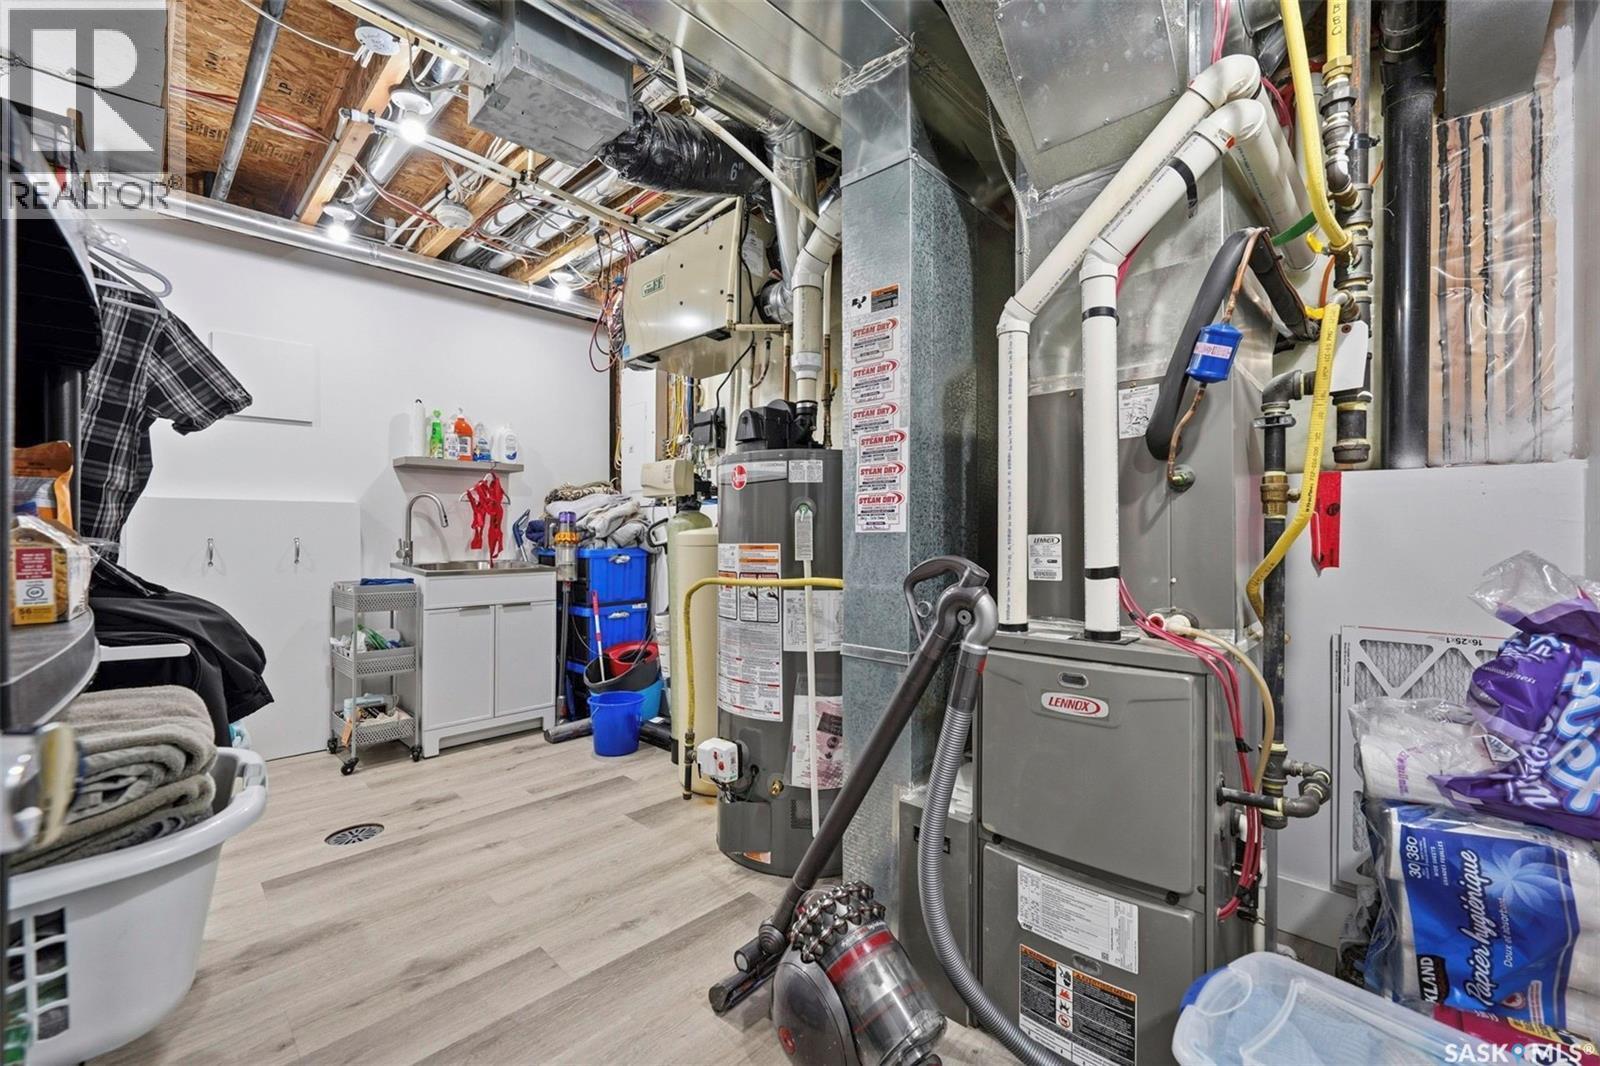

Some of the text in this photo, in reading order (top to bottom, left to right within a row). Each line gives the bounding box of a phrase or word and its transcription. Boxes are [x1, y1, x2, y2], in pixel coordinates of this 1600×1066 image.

[852, 322, 891, 337] STEAM DRY
[853, 363, 891, 378] STEAM DRY
[852, 406, 890, 419] STEAM DRY
[861, 434, 899, 446] STEAM DRY
[860, 466, 898, 476] STEAM DRY
[859, 496, 896, 505] STEAM DRY
[1048, 696, 1091, 712] LENNOX
[1405, 835, 1422, 880] 30 380
[1460, 849, 1498, 948] hygiénique
[1503, 934, 1513, 946] et
[1503, 944, 1513, 968] Doux
[1465, 941, 1495, 1007] Papier
